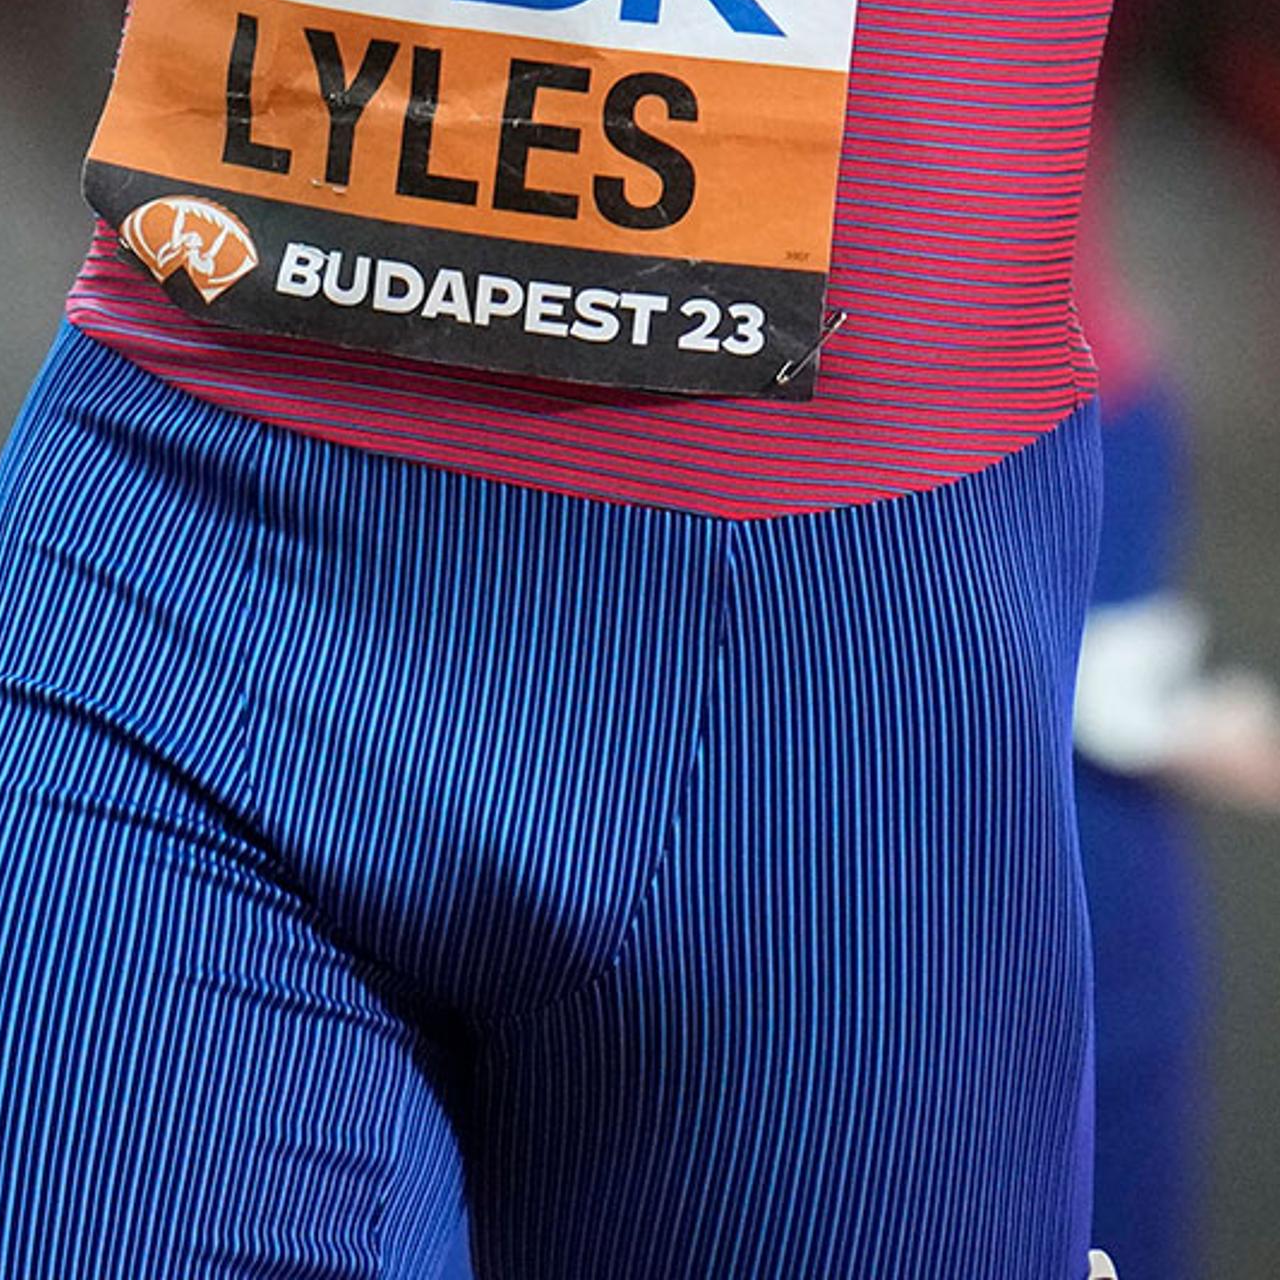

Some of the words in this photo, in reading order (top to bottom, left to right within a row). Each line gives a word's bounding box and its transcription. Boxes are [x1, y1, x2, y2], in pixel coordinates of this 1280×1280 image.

[221, 12, 699, 231] LYLES
[275, 242, 669, 346] BUDAPEST
[677, 299, 766, 356] 23
